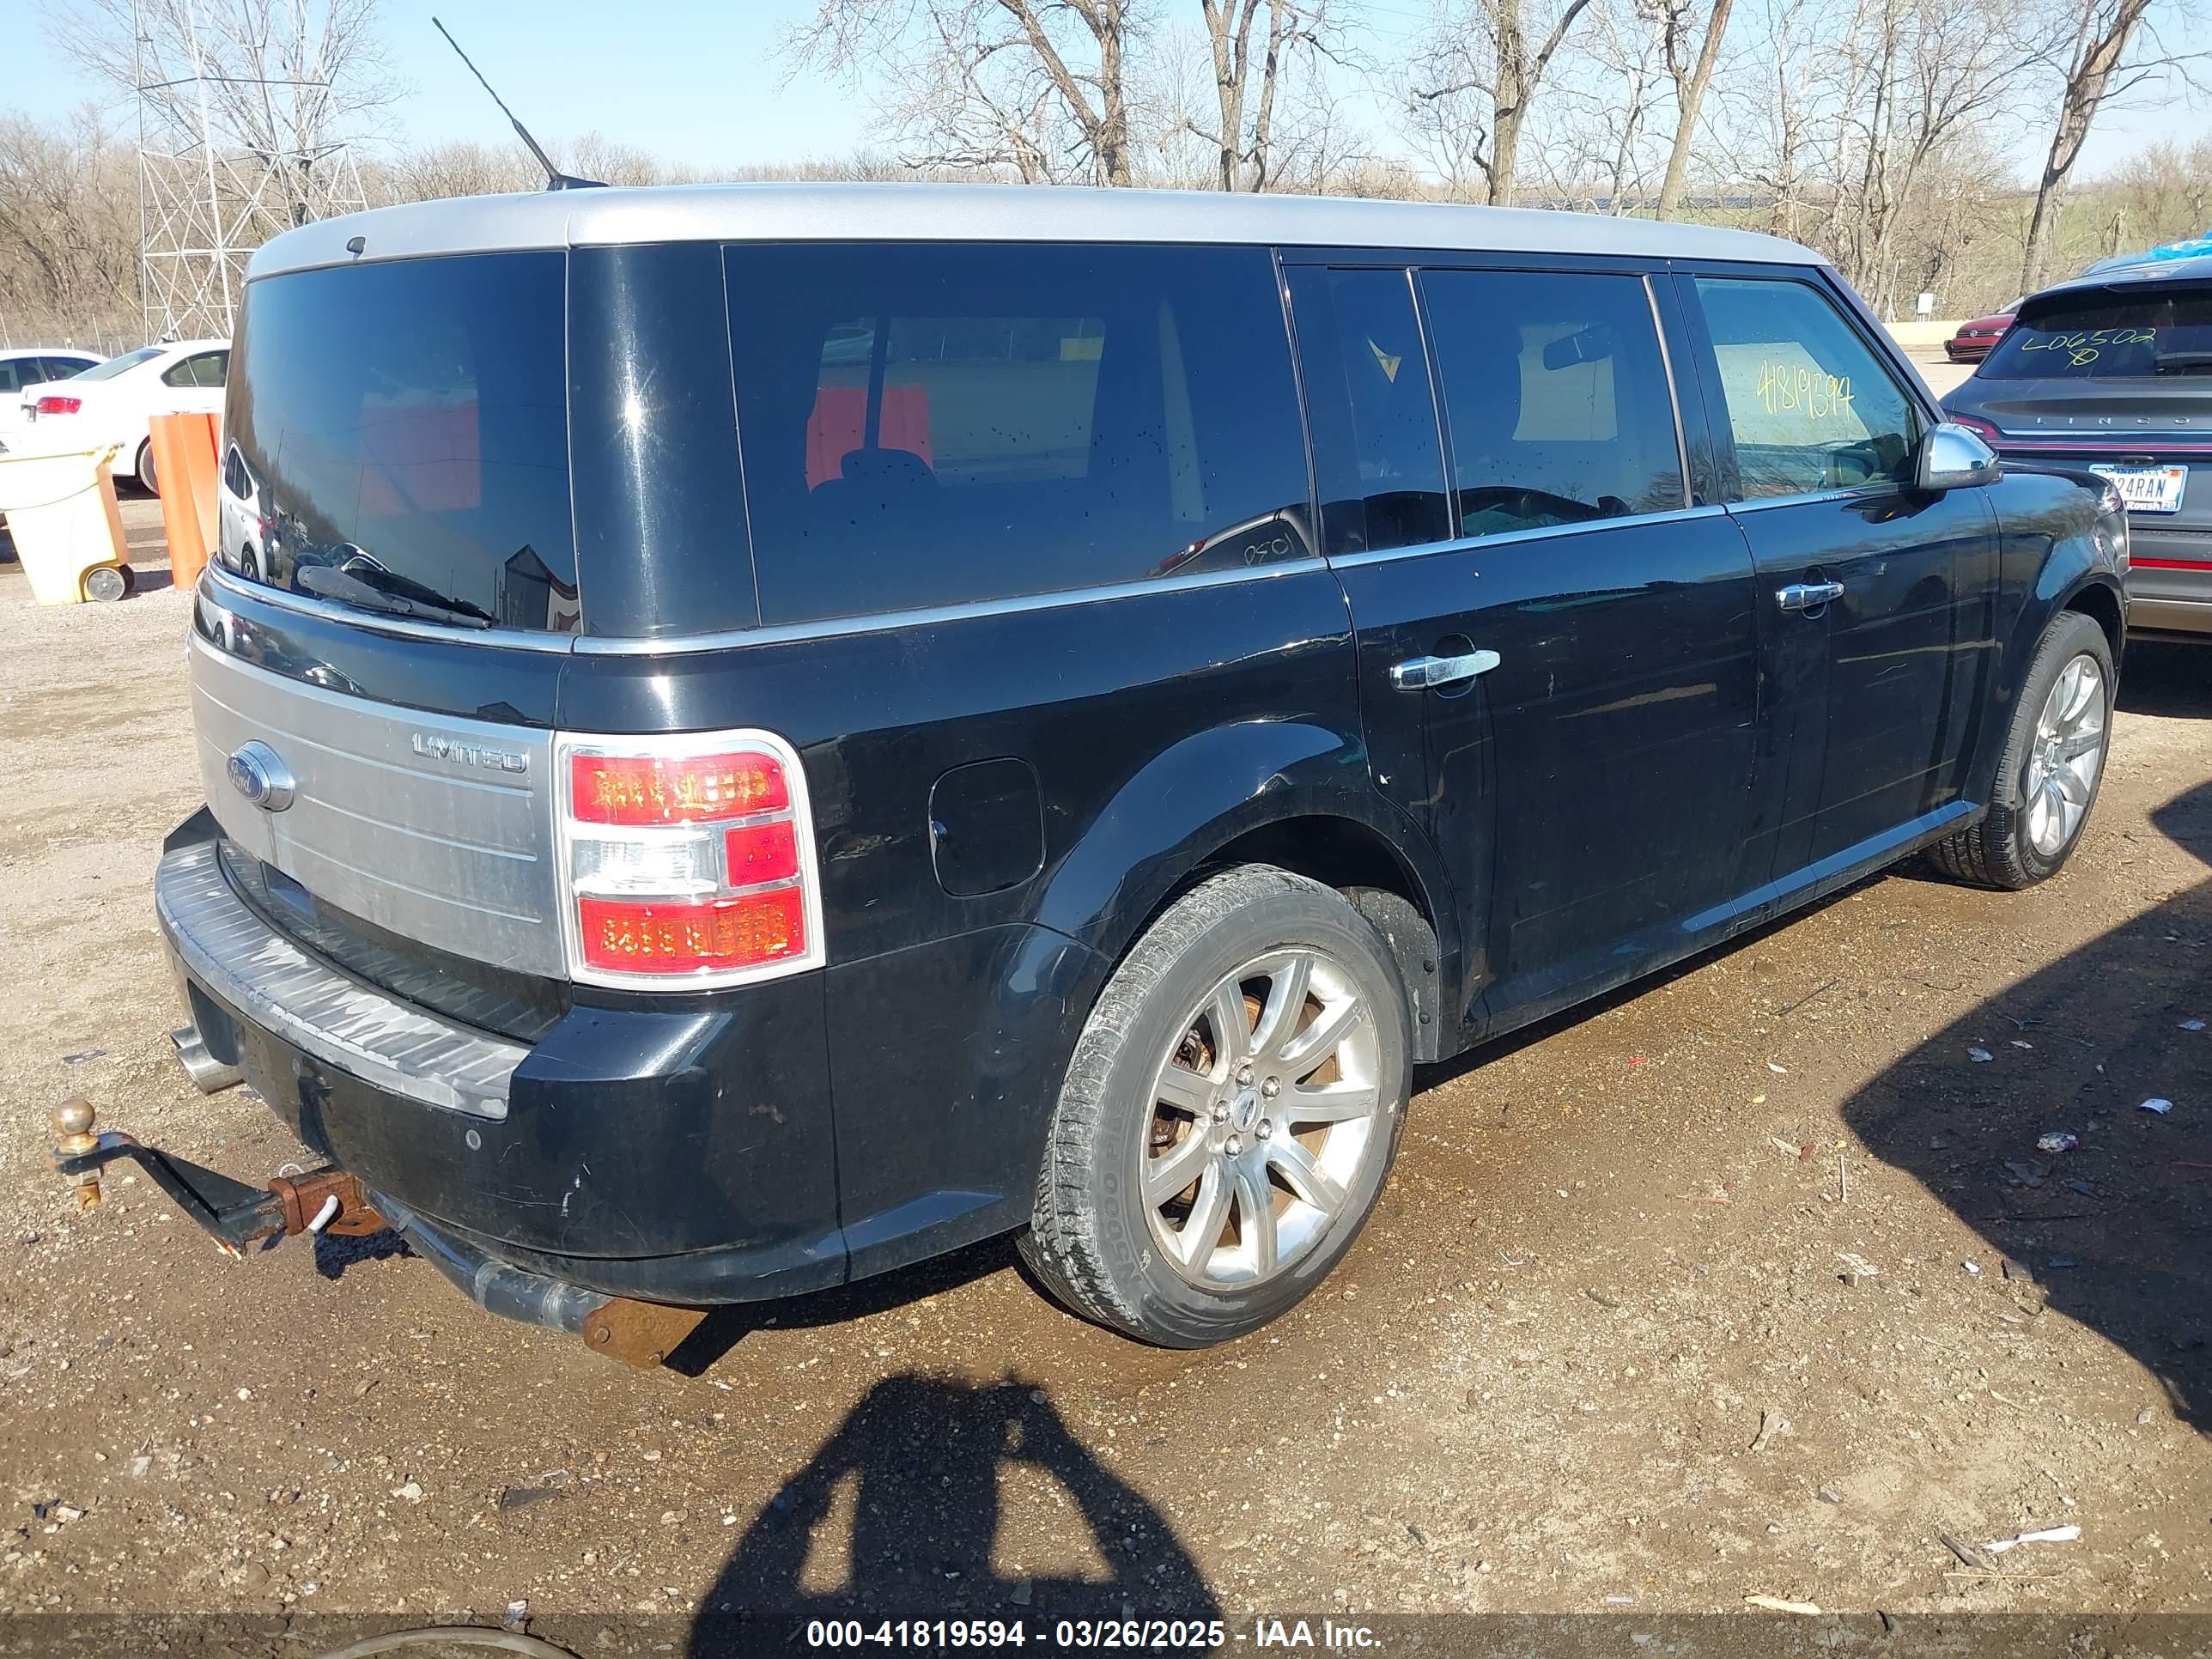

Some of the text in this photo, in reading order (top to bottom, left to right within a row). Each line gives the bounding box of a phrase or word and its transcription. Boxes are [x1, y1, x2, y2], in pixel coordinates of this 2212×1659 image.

[1756, 358, 1856, 422] 41819594
[412, 732, 527, 773] LIMITED
[228, 758, 252, 793] Ford
